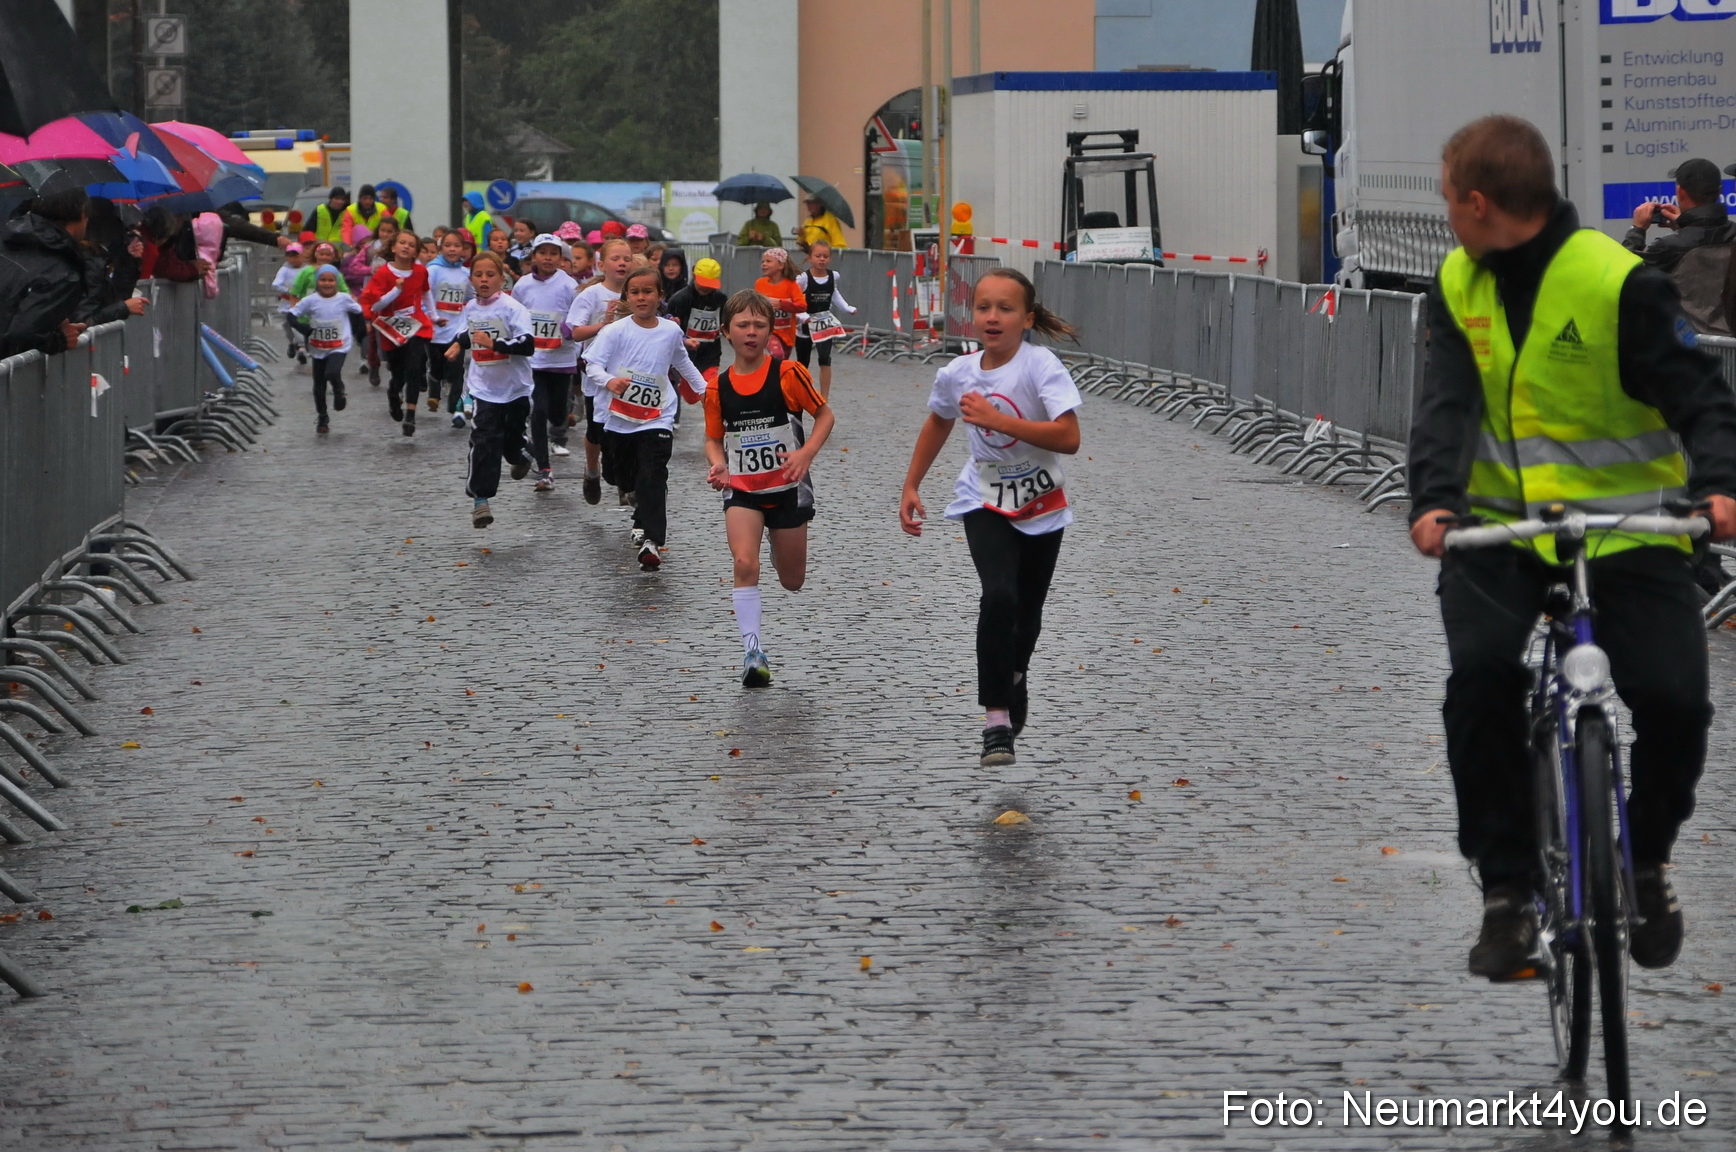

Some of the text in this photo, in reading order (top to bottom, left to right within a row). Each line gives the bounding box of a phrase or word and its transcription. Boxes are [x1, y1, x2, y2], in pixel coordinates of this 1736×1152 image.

[1623, 49, 1724, 67] Entwicklung
[1624, 71, 1717, 88] Formenbau
[1625, 139, 1689, 157] Logistik
[740, 432, 770, 444] BOCK
[990, 468, 1055, 509] 7139
